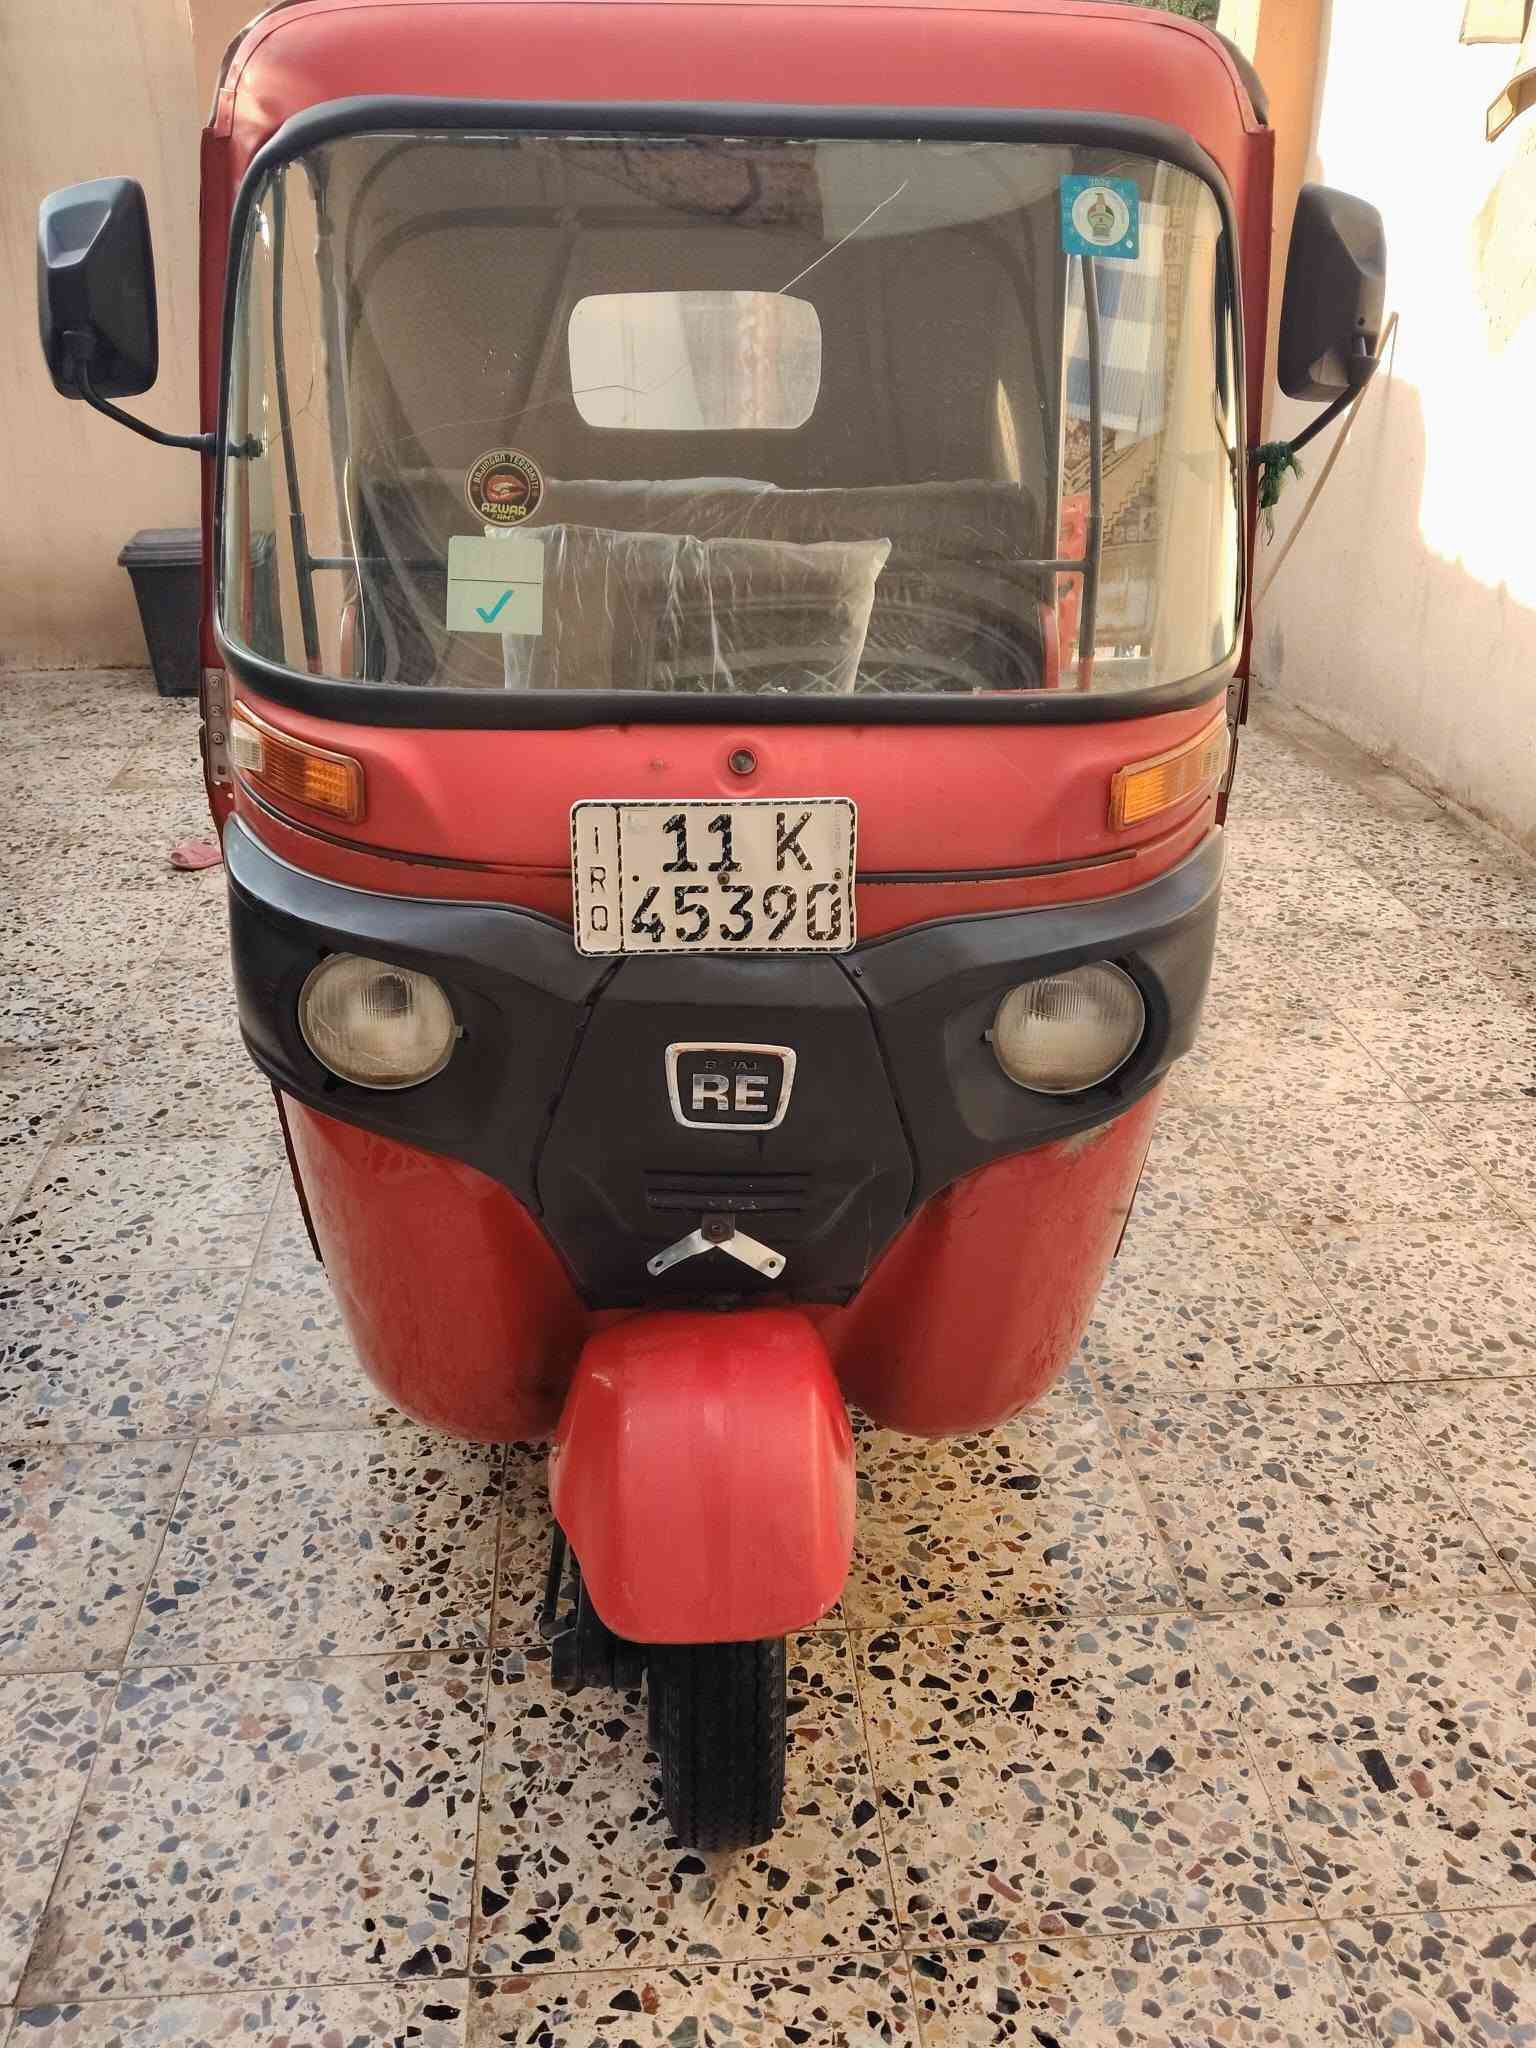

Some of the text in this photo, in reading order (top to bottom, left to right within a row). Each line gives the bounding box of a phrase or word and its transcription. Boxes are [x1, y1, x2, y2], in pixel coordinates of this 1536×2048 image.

[481, 502, 527, 516] AZWAR
[662, 813, 743, 873] 11
[776, 812, 813, 872] K
[631, 884, 842, 943] 45390
[692, 1073, 768, 1112] RE
